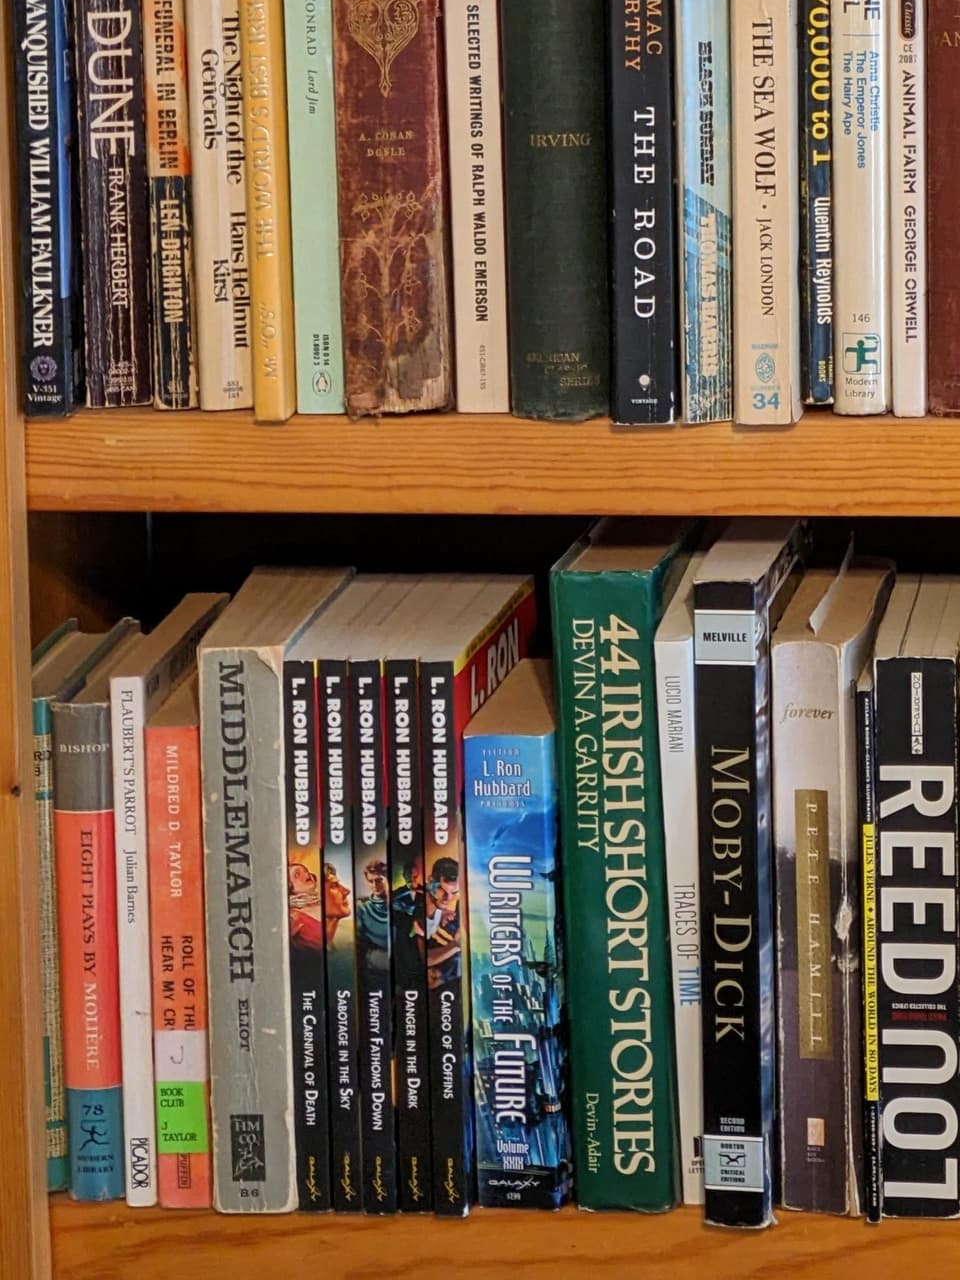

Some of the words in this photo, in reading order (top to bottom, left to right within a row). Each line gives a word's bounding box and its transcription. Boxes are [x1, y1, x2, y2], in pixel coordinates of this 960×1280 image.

[465, 5, 482, 69] SELECTED
[87, 11, 135, 160] DUNE
[469, 76, 484, 137] WRITINGS
[903, 70, 917, 138] ANIMAL
[471, 142, 484, 158] OF
[530, 133, 592, 147] IRVING
[634, 107, 655, 184] THE
[904, 145, 917, 193] FARM
[29, 138, 52, 234] WILLIAM
[472, 165, 485, 205] RALPH
[472, 213, 486, 255] WALDO
[634, 208, 655, 318] ROAD
[904, 205, 917, 272] GEORGE
[31, 239, 53, 348] FAULKNER
[474, 261, 488, 322] EMERSON
[905, 278, 917, 343] ORWELL
[572, 617, 596, 701] DEVIN
[599, 614, 642, 676] 44
[703, 632, 747, 642] MELVILLE
[292, 678, 305, 696] L.
[292, 701, 307, 745] RON
[575, 706, 589, 732] A.
[601, 683, 645, 815] IRISH
[219, 661, 255, 983] MIDDLEMARCH
[293, 750, 310, 846] HUBBARD
[575, 733, 600, 853] GARRITY
[602, 818, 652, 986] SHORT
[710, 745, 752, 1043] MOBY-DICK
[879, 765, 957, 996] REED
[866, 918, 876, 957] AROUND
[867, 963, 876, 981] THE
[867, 985, 877, 1025] WORLD
[868, 1030, 877, 1039] IN
[608, 987, 656, 1176] STORIES
[868, 1044, 877, 1059] 80
[868, 1062, 878, 1093] DAYS
[882, 1029, 959, 1200] LOU
[131, 1138, 148, 1188] PICADOR
